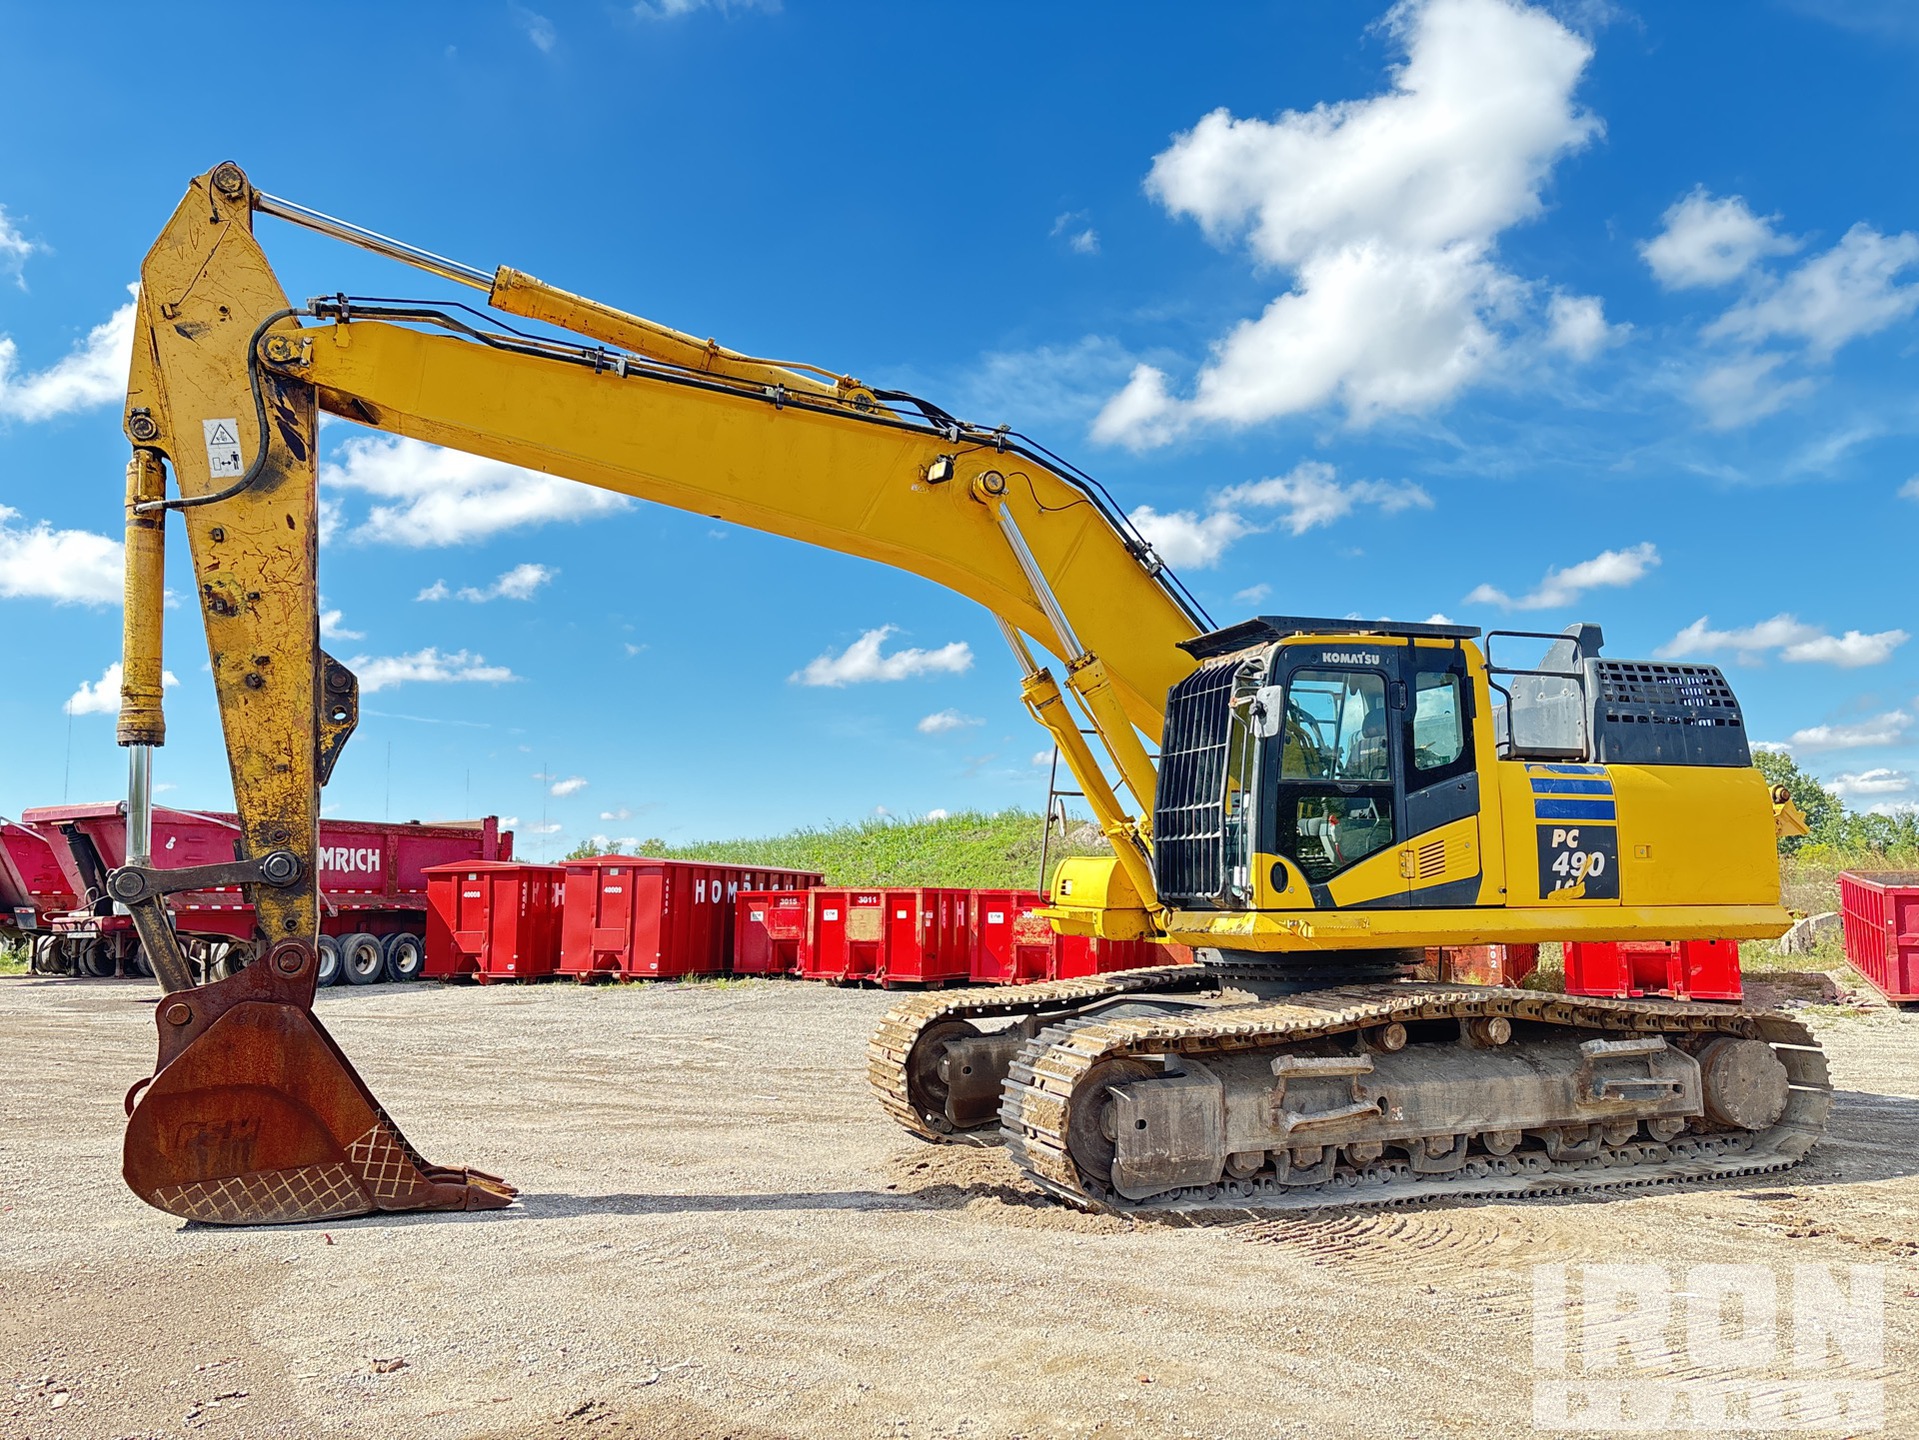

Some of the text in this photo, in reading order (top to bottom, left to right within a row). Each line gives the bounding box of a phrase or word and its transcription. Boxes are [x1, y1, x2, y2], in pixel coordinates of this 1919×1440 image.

[1322, 651, 1380, 665] KOMATSU
[1551, 829, 1579, 848] PC
[319, 847, 380, 873] MRICH
[1552, 851, 1605, 877] 490
[858, 896, 877, 904] 3011
